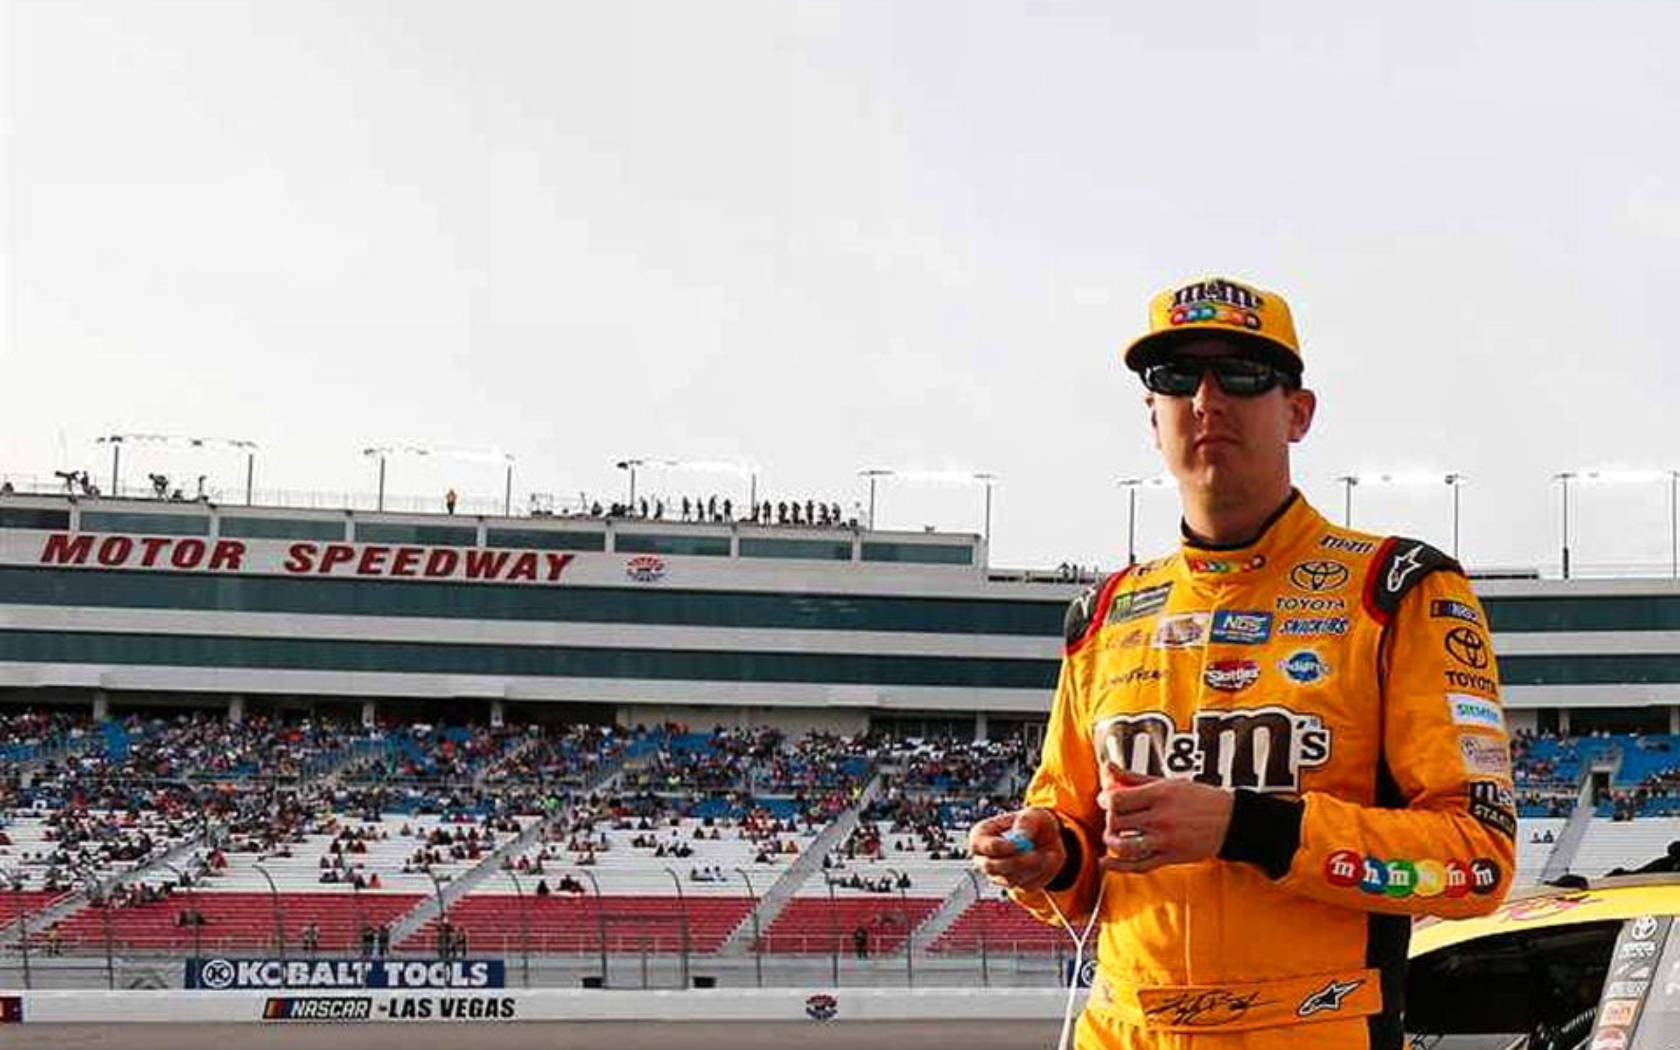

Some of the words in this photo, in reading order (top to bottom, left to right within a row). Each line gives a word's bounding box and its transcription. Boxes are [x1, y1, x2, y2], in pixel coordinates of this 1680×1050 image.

[40, 533, 246, 571] MOTOR
[284, 542, 575, 582] SPEEDWAY
[1277, 597, 1345, 611] TOYOTA
[237, 961, 372, 987] KOBALT
[384, 961, 489, 987] TOOLS
[290, 999, 369, 1019] NASCAR
[440, 998, 516, 1019] VEGAS
